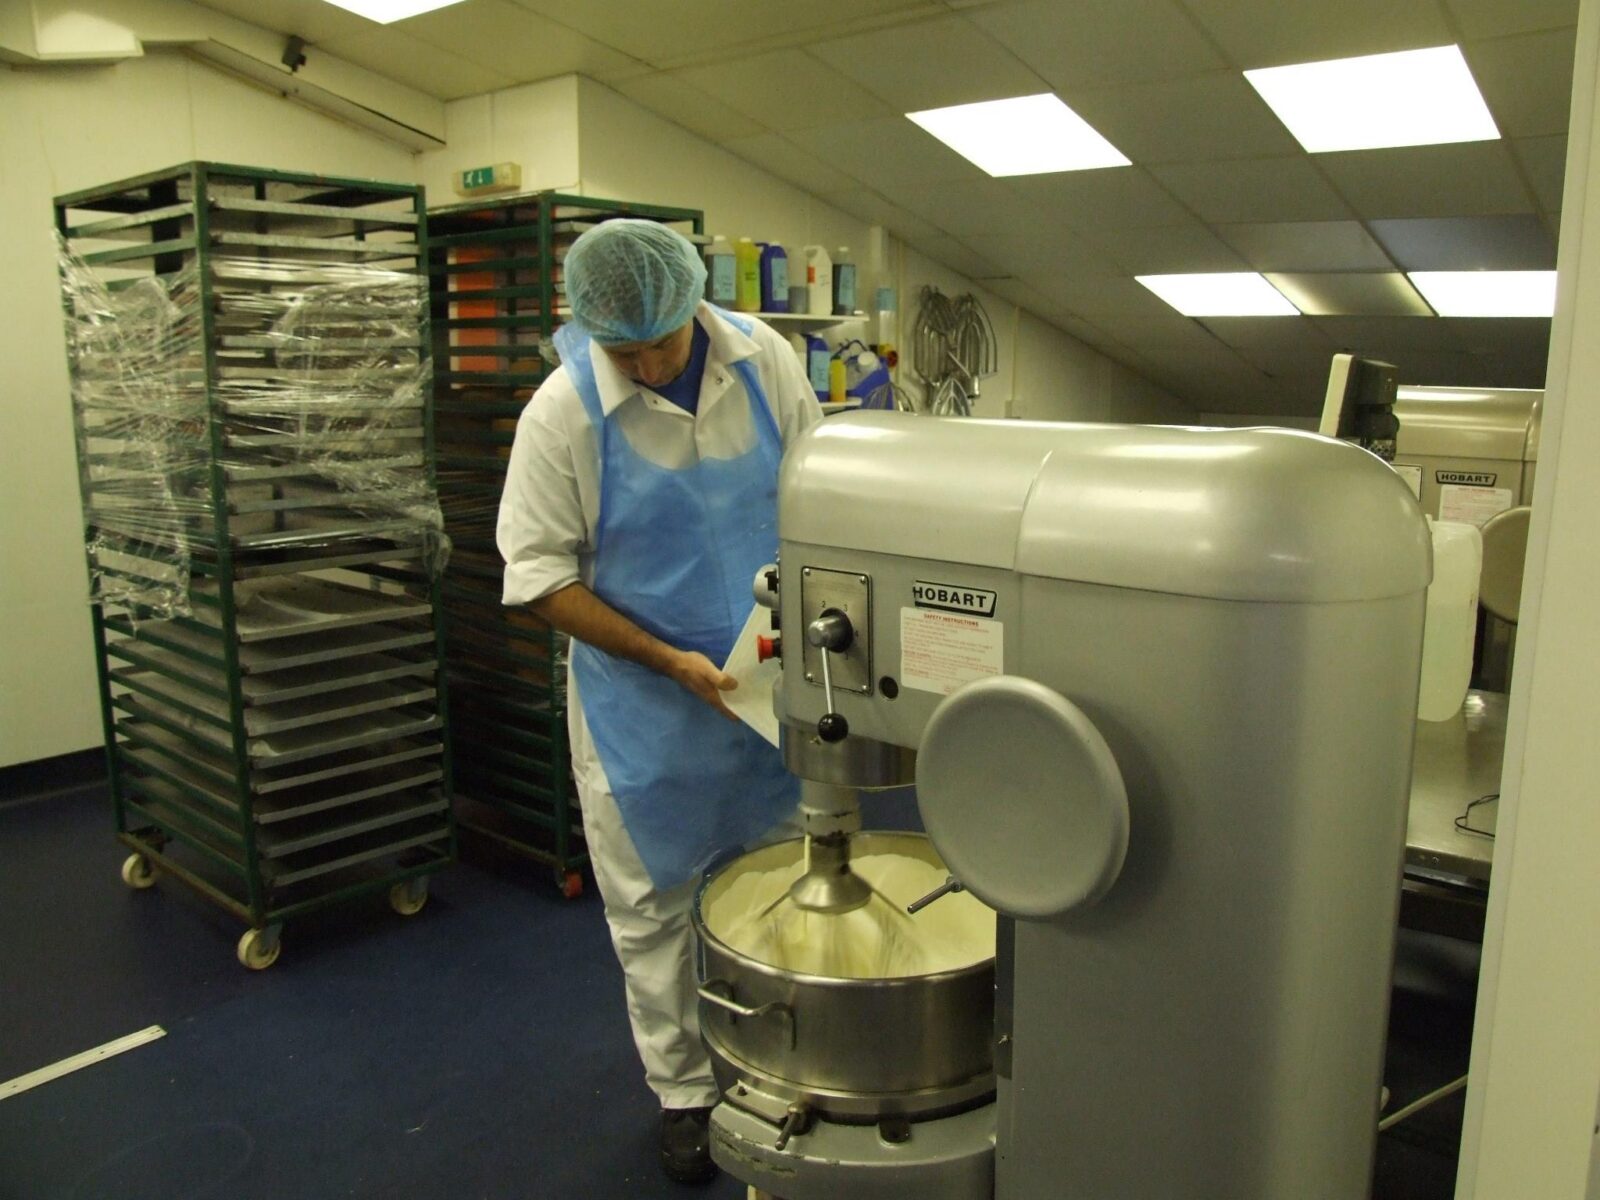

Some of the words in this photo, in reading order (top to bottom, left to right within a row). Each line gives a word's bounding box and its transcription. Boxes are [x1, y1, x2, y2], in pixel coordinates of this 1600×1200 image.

[1441, 473, 1491, 483] HOBART
[912, 586, 987, 608] HOBART
[923, 613, 942, 622] SAFETY
[942, 616, 979, 627] INSTRUCTIONS
